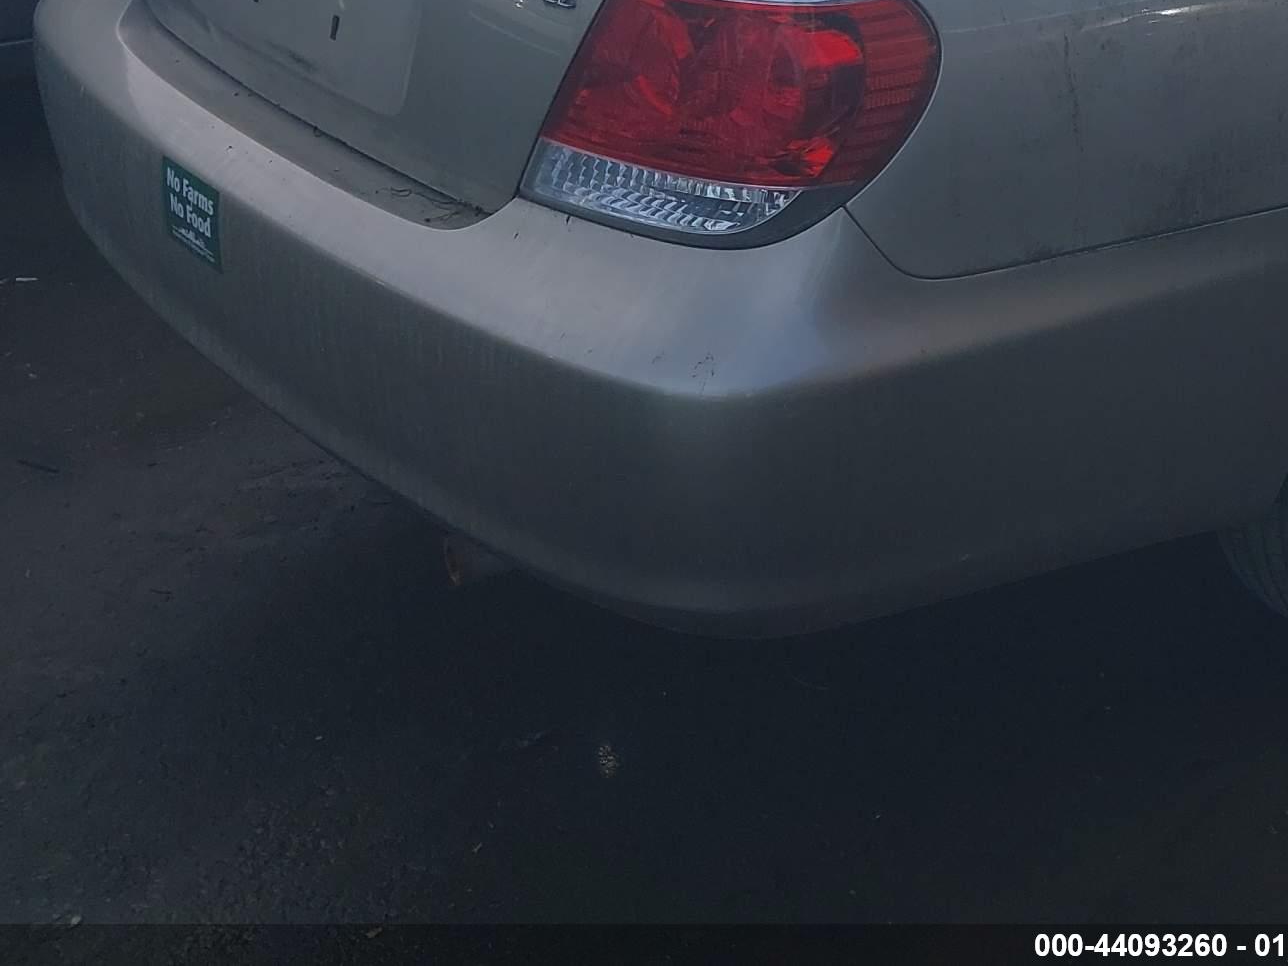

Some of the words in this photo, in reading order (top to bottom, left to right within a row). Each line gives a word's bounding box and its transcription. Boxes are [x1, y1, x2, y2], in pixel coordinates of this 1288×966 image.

[166, 166, 180, 193] No
[182, 177, 214, 216] Farms
[170, 192, 184, 219] No
[186, 204, 211, 238] Food
